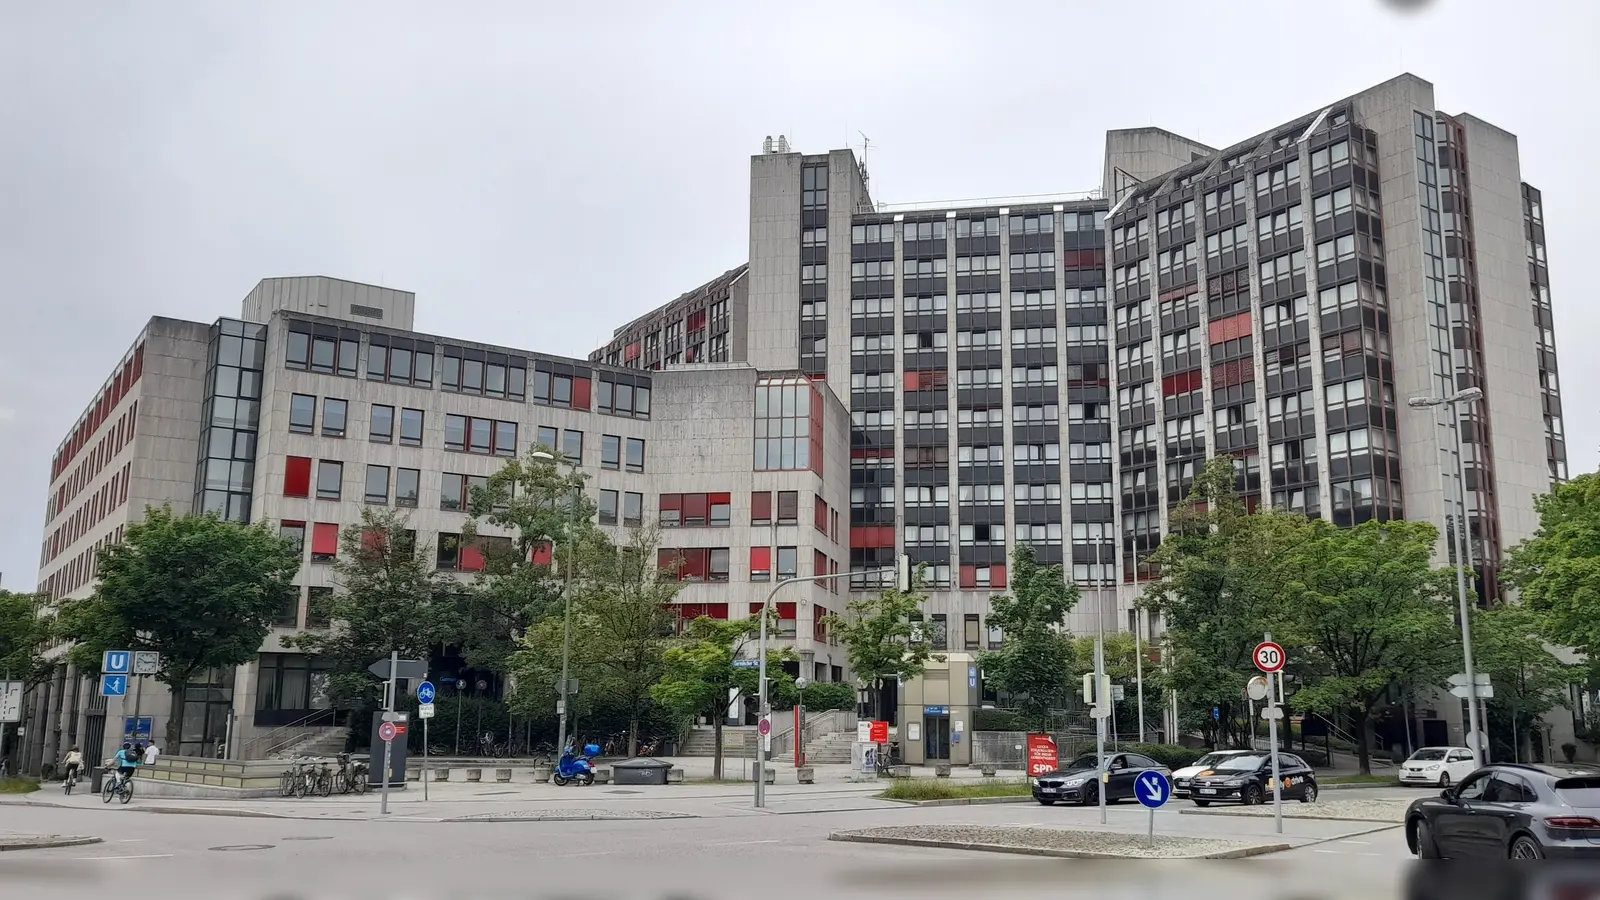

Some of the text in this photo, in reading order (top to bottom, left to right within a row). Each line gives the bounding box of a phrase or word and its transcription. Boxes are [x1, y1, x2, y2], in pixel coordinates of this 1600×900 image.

[111, 654, 124, 669] U
[1260, 650, 1278, 664] 30
[1033, 763, 1053, 773] SPD
